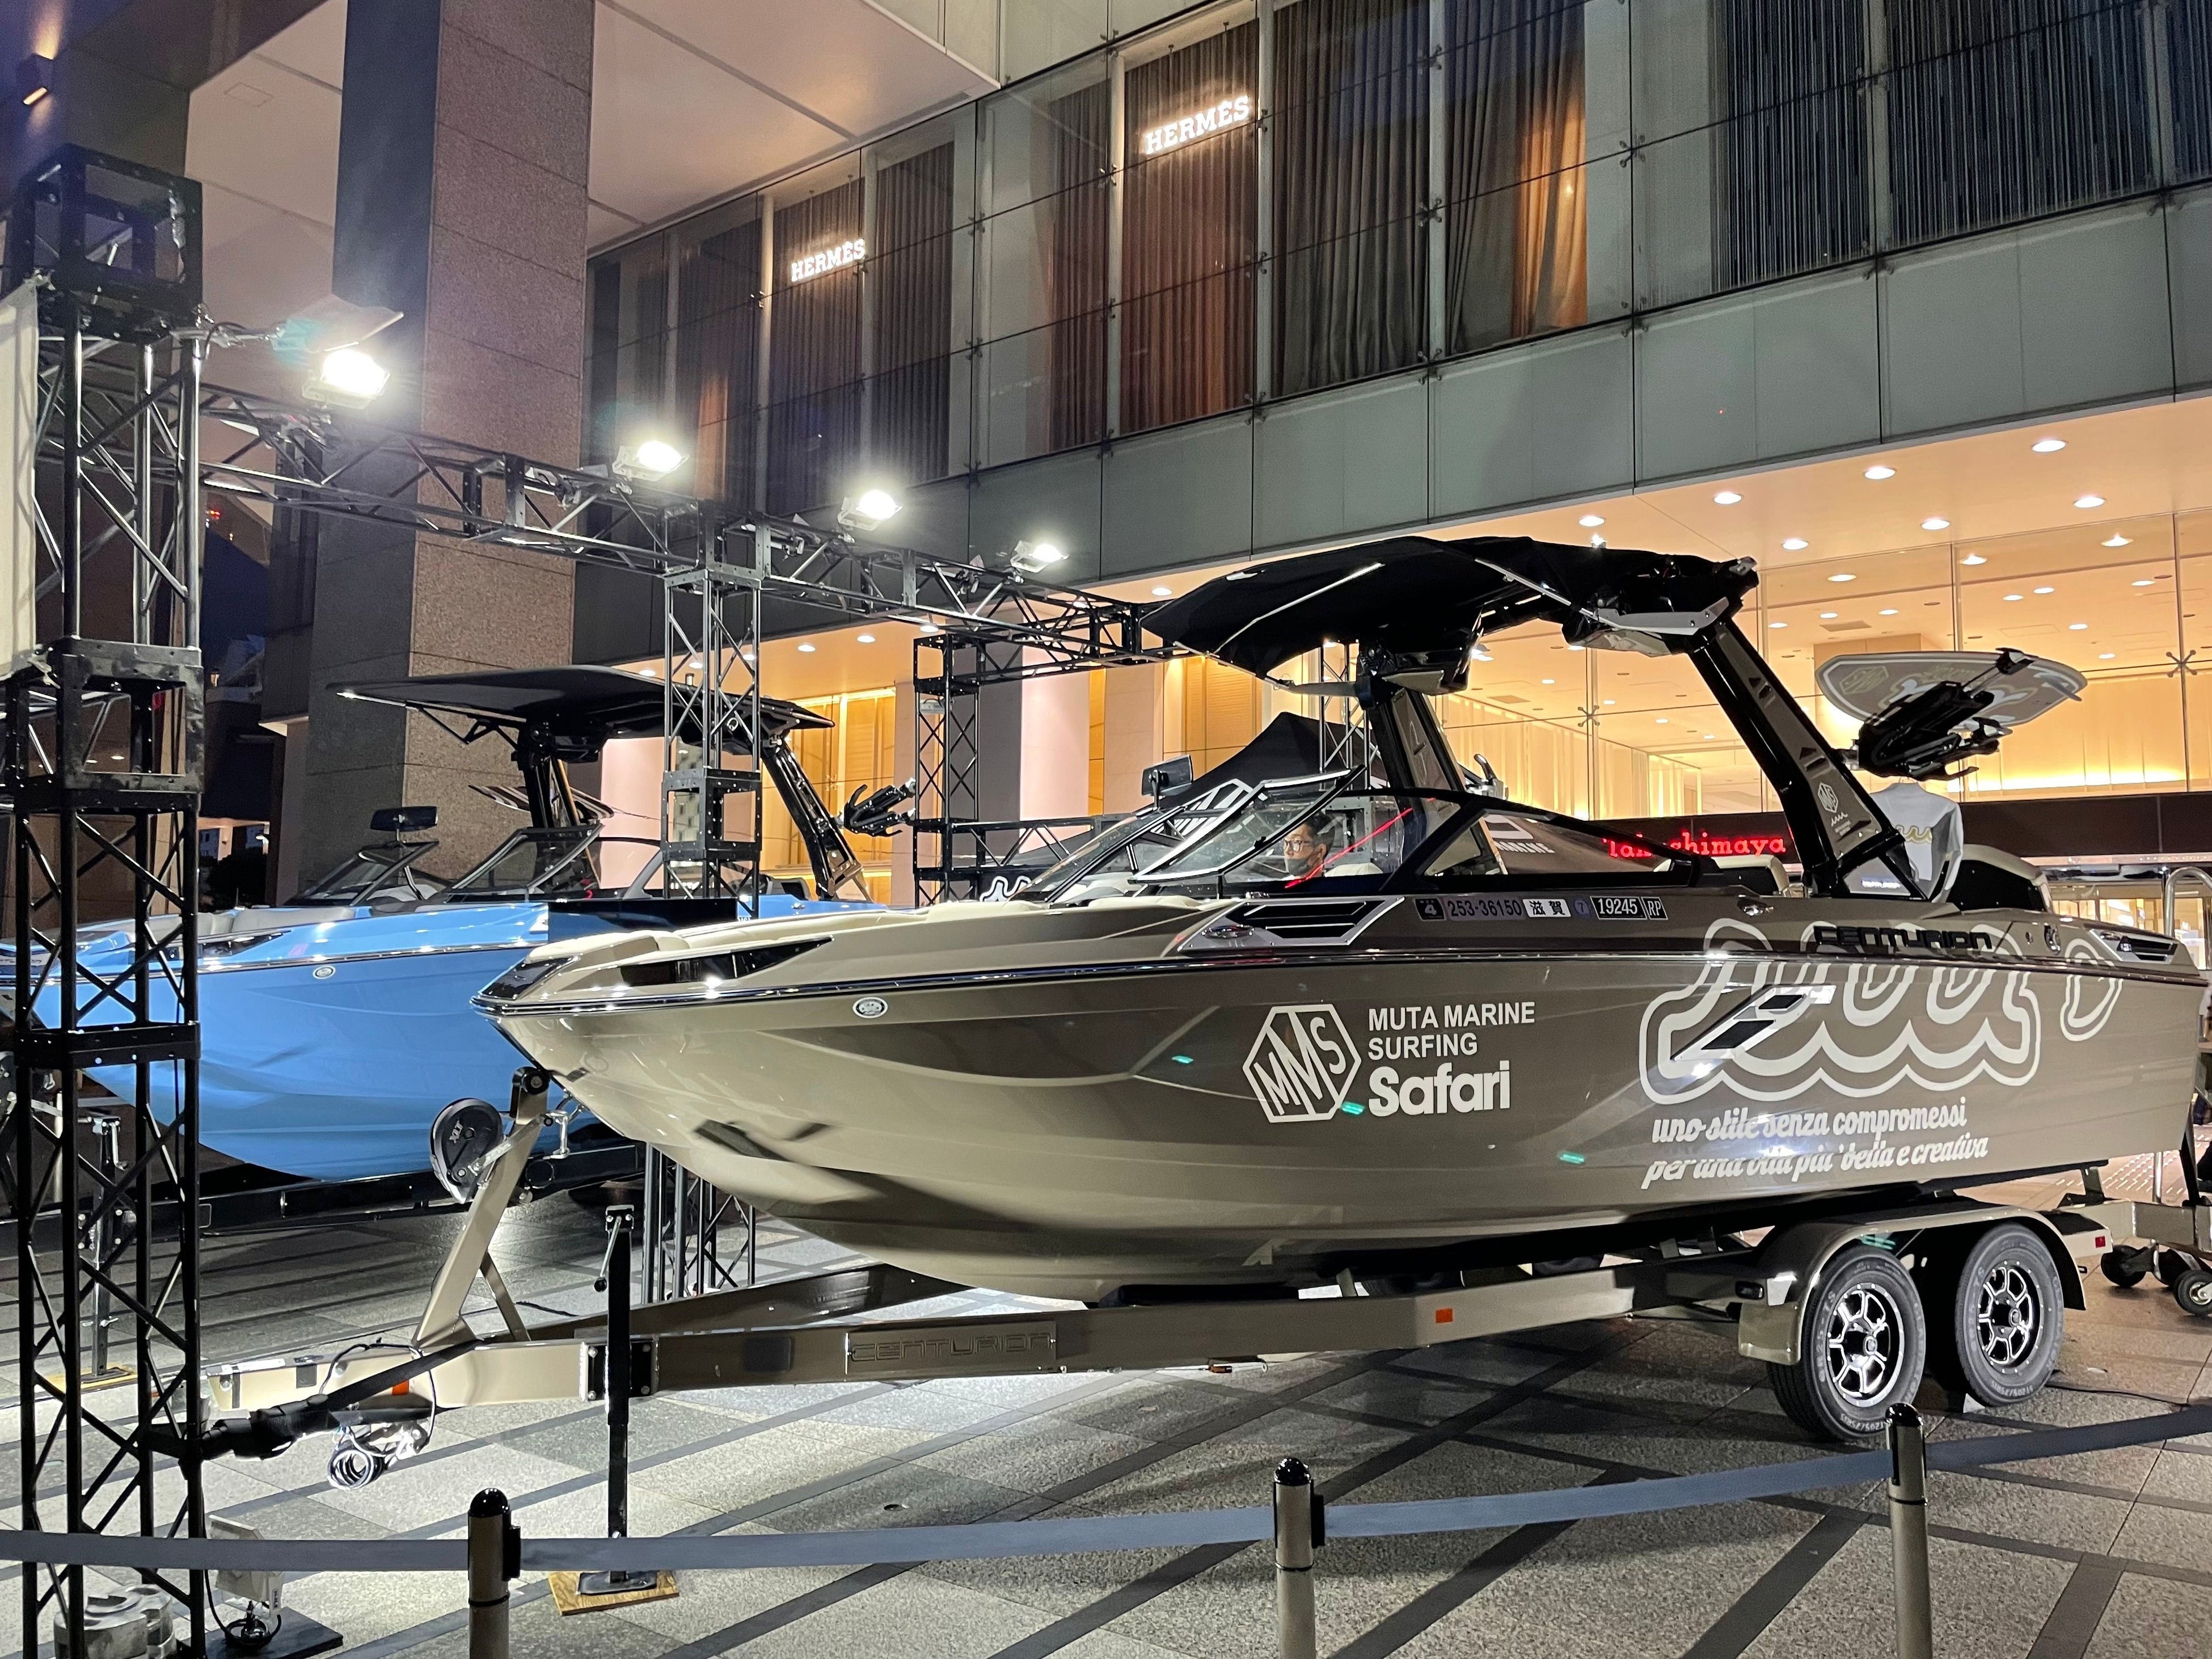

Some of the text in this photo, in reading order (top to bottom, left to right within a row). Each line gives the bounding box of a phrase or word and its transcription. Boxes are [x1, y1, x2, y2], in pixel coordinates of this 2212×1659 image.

[1602, 832, 1786, 856] Tashimaya
[1529, 900, 1565, 915] 滋賀
[1598, 898, 1661, 916] 19245 RP
[1814, 926, 1992, 949] CENTURION
[1369, 1002, 1535, 1031] MUTA MARINE
[1368, 1032, 1478, 1060] SURFING
[1368, 1060, 1510, 1117] Safari
[1652, 1118, 1706, 1143] uno
[1762, 1112, 1830, 1138] senza
[1833, 1096, 1967, 1142] compromessi
[1641, 1159, 1697, 1189] per
[1896, 1146, 1911, 1166] e
[1910, 1132, 1989, 1164] creativa
[851, 1332, 1051, 1362] CENTURION
